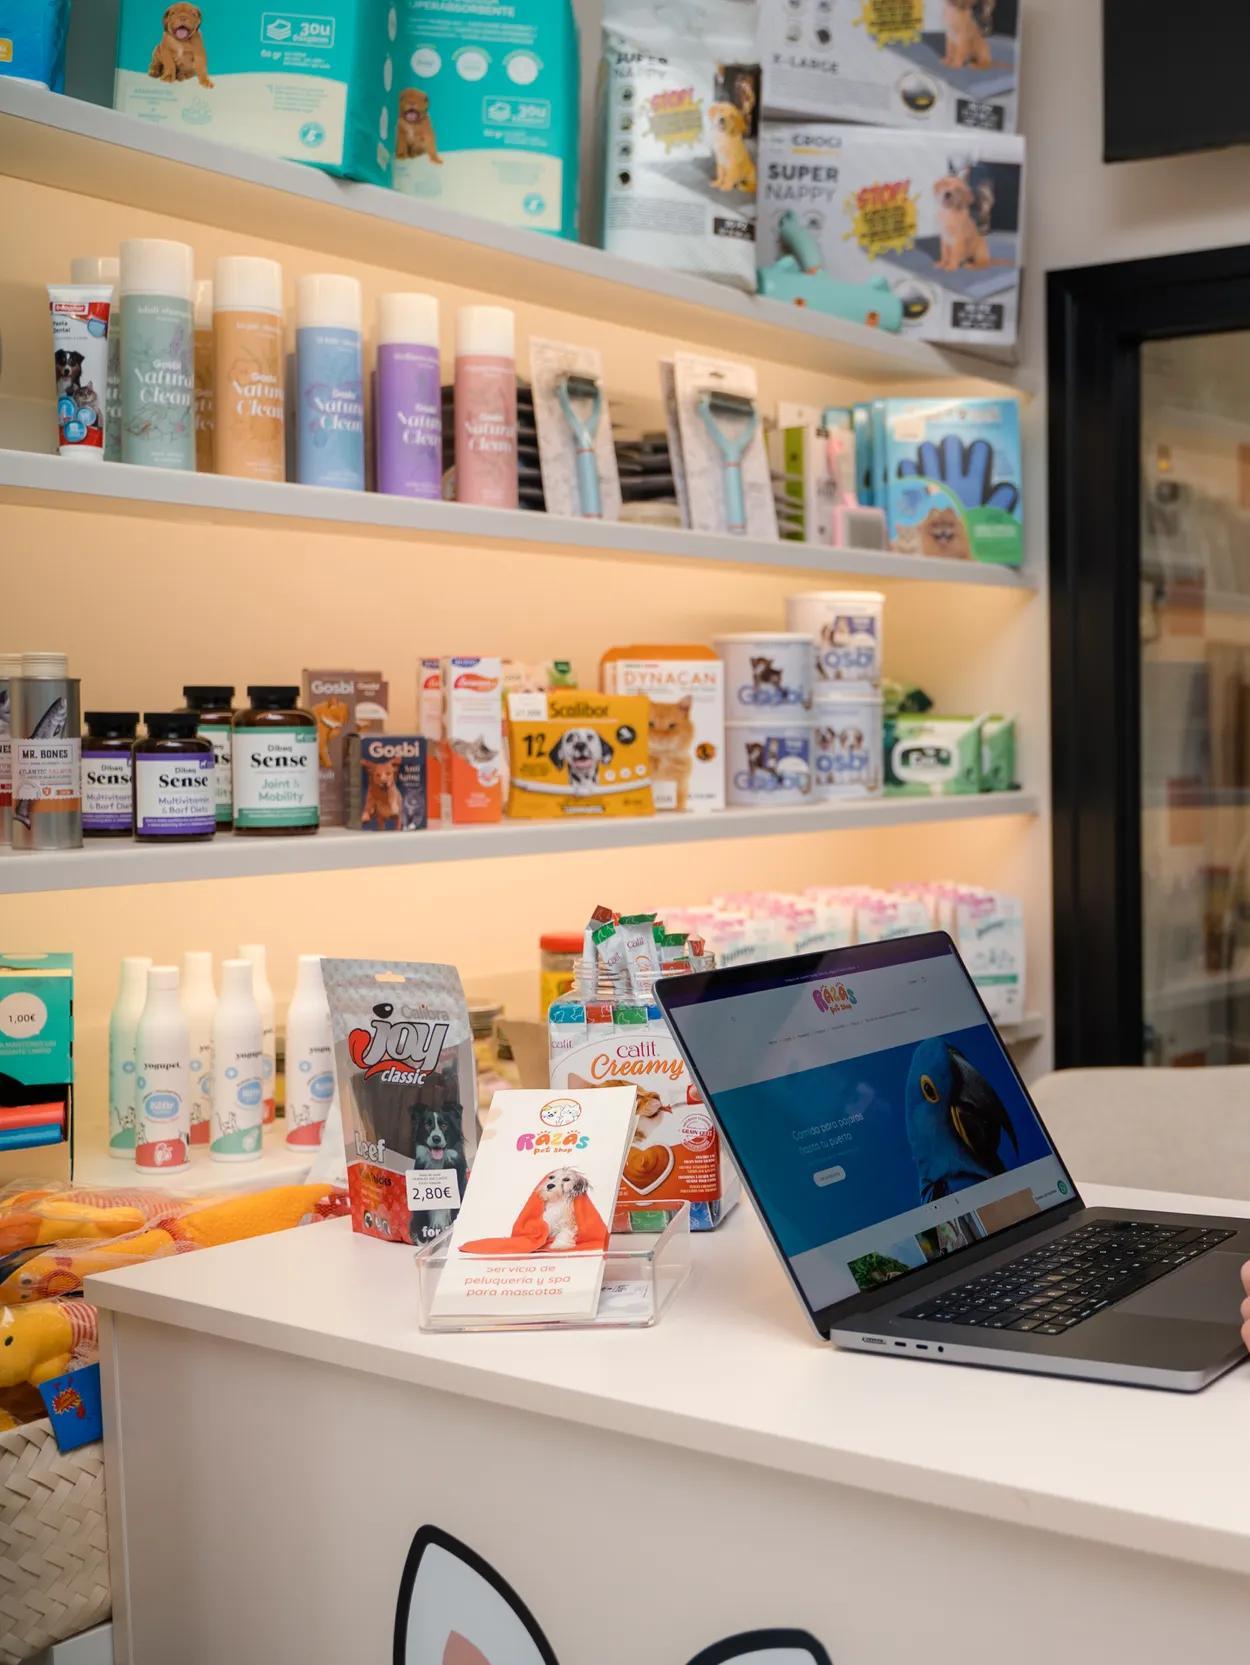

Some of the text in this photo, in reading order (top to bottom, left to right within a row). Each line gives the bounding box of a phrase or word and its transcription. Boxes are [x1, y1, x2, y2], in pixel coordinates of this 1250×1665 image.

[768, 163, 839, 182] SUPER
[765, 183, 837, 204] NAPPY
[623, 670, 717, 685] DYNACAN
[310, 680, 355, 696] Gosbi
[550, 702, 610, 719] Scalibor
[267, 744, 293, 753] Dibaq
[368, 740, 421, 758] Gosbi
[522, 733, 547, 758] 12
[22, 749, 68, 759] MR. BONES
[250, 752, 308, 769] Sense
[158, 773, 209, 789] Sense
[261, 778, 290, 790] Joint
[258, 791, 305, 803] Mobility
[9, 1014, 36, 1024] 1,00€
[401, 1004, 450, 1020] Calibra
[616, 1040, 657, 1058] catit
[591, 1053, 686, 1081] Creamy
[381, 1066, 427, 1085] classic
[516, 1132, 591, 1152] RAZAS
[412, 1186, 452, 1202] 2,80€
[421, 1226, 441, 1238] for
[540, 1264, 556, 1273] de
[537, 1278, 544, 1286] y
[548, 1275, 571, 1284] spa
[466, 1287, 564, 1297] para mascotas
